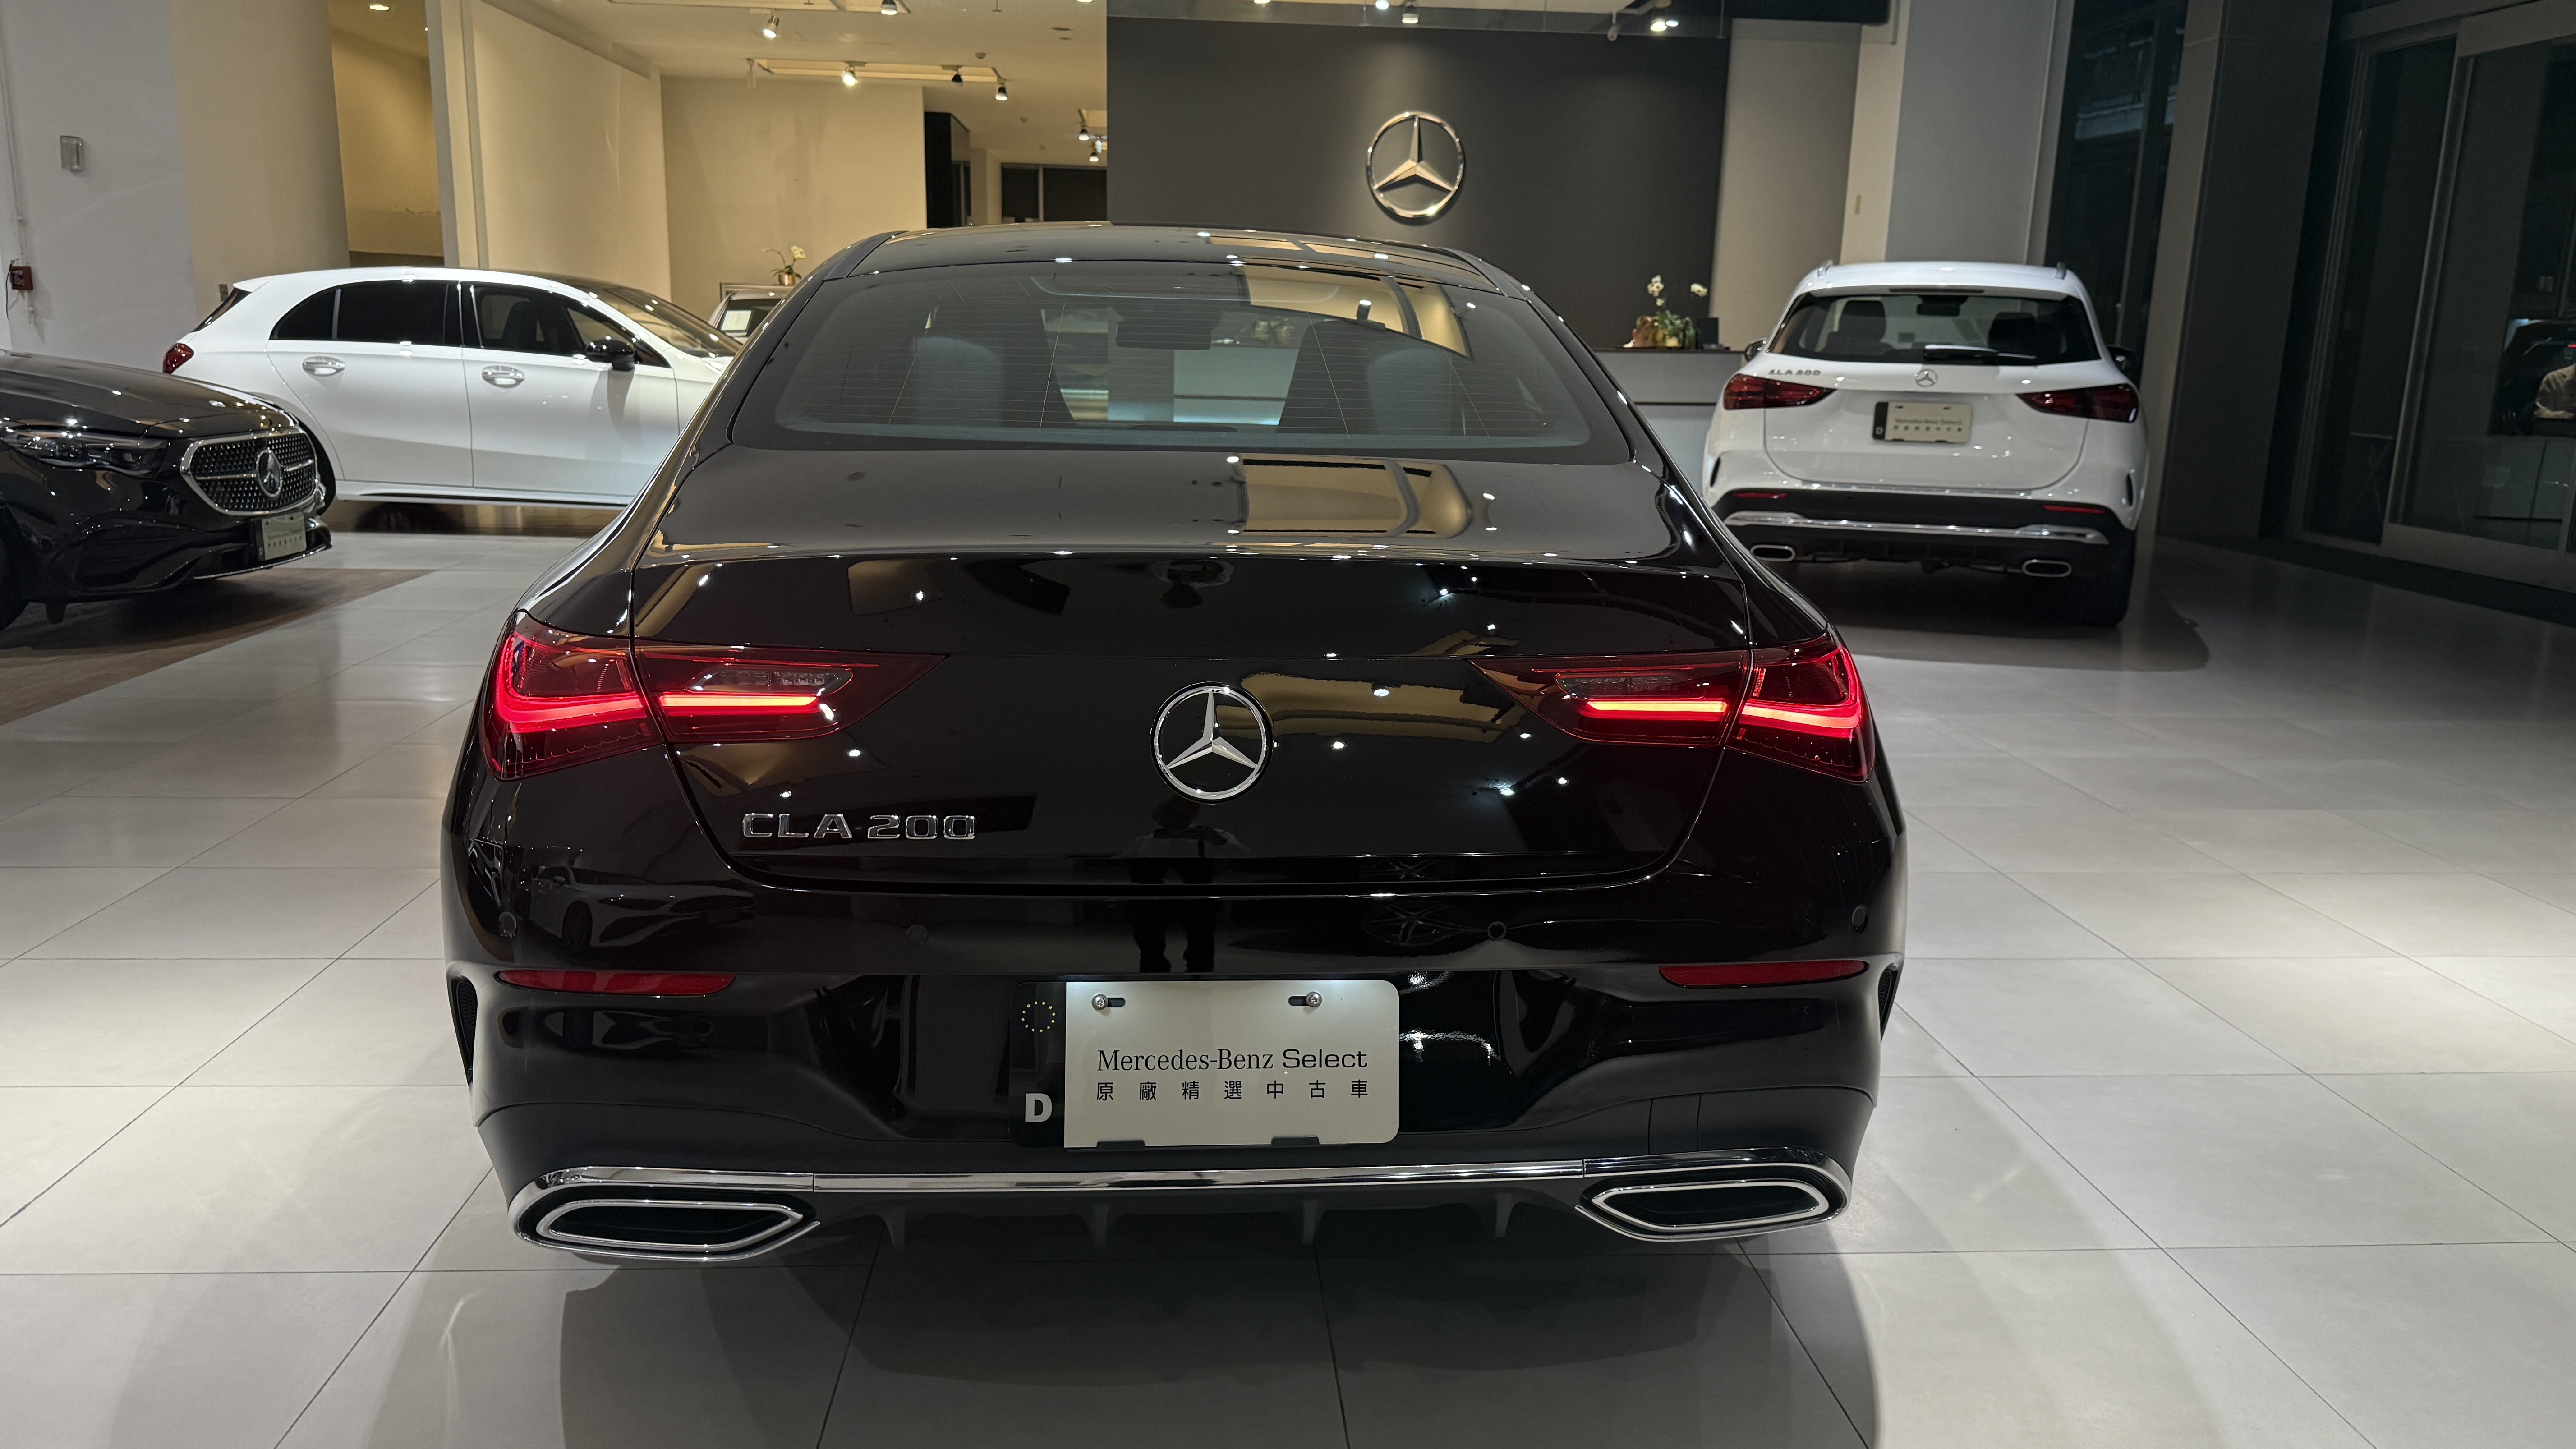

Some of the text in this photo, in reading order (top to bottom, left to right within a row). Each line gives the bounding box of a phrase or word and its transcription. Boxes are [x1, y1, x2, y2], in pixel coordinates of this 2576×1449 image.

[742, 813, 977, 840] CLA 200
[1097, 1049, 1368, 1072] Mercedes-Benz Select
[1096, 1078, 1369, 1101] 原廠精選中古車
[1025, 1093, 1053, 1123] D
